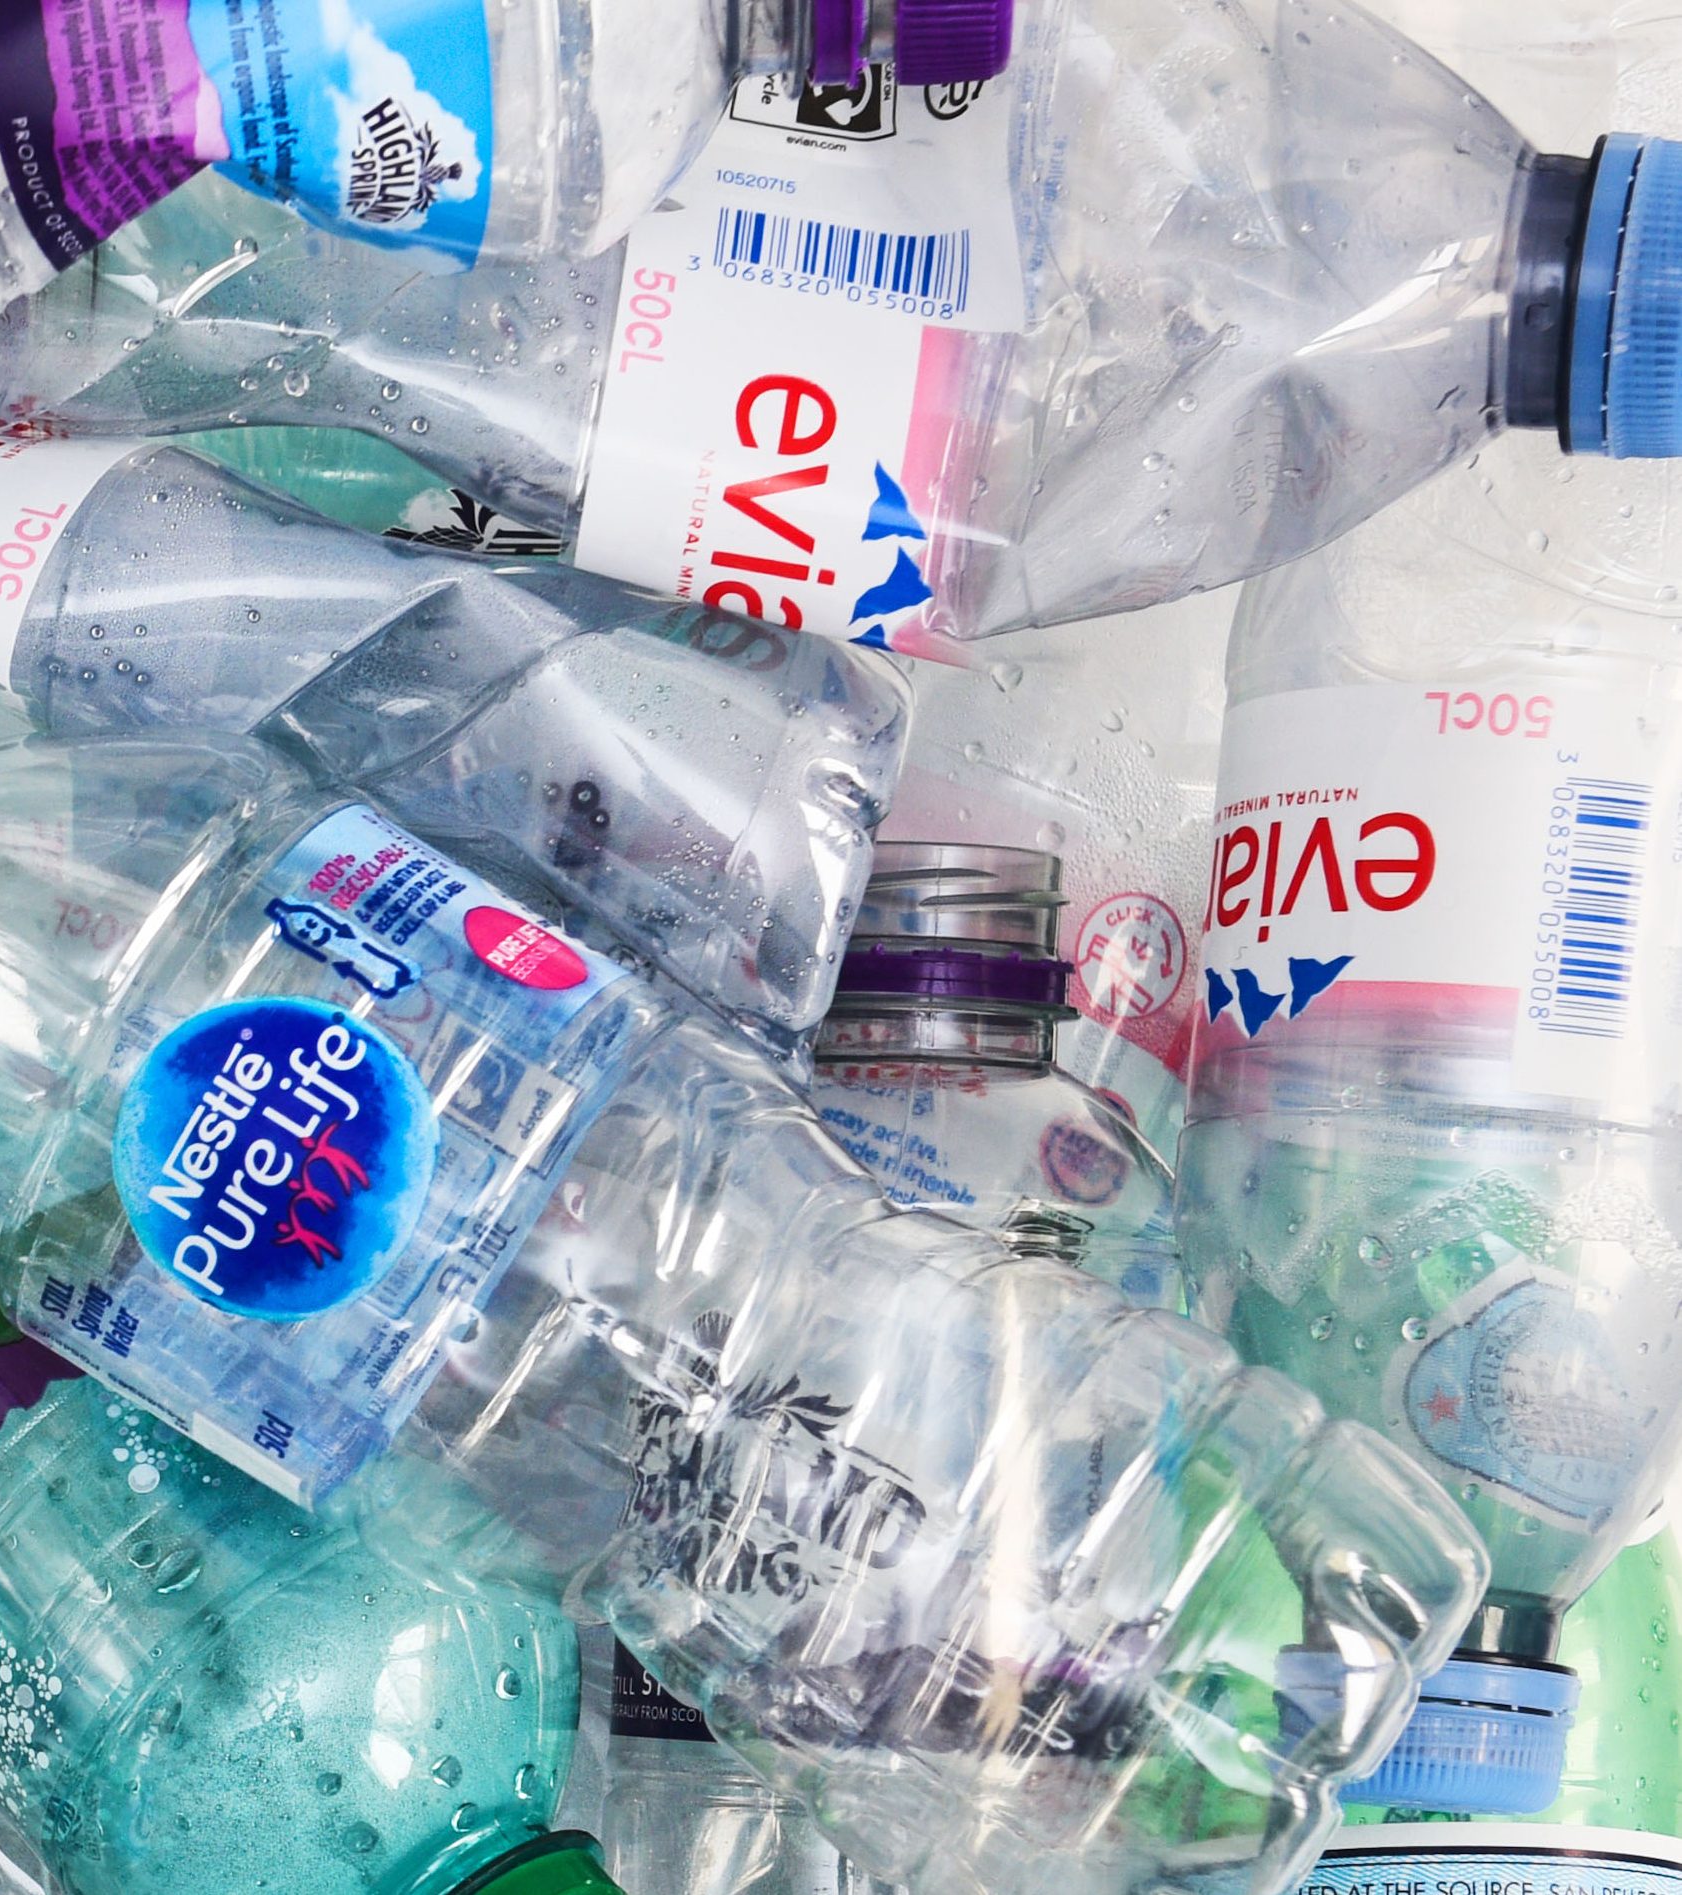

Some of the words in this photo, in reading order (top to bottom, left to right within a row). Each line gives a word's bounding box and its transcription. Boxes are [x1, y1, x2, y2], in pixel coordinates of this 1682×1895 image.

[12, 116, 57, 214] PRODUCT
[785, 134, 848, 153] evian.com
[717, 169, 797, 195] 10520715
[686, 253, 701, 272] 3
[723, 260, 831, 297] 068320
[846, 285, 955, 322] 055008
[683, 449, 716, 557] NATURAL
[1275, 786, 1360, 809] NATURAL
[1542, 785, 1576, 896] 068320
[308, 853, 357, 893] 100%
[485, 934, 529, 970] PURE
[1527, 911, 1562, 1021] 055008
[148, 1040, 273, 1222] Nestlé
[172, 1140, 293, 1297] Pure
[262, 1022, 367, 1136] Life
[38, 1275, 76, 1321] STILL
[71, 1282, 116, 1342] Spring
[101, 1306, 143, 1360] Water
[252, 1410, 298, 1461] 50cl
[640, 1704, 669, 1721] FROM
